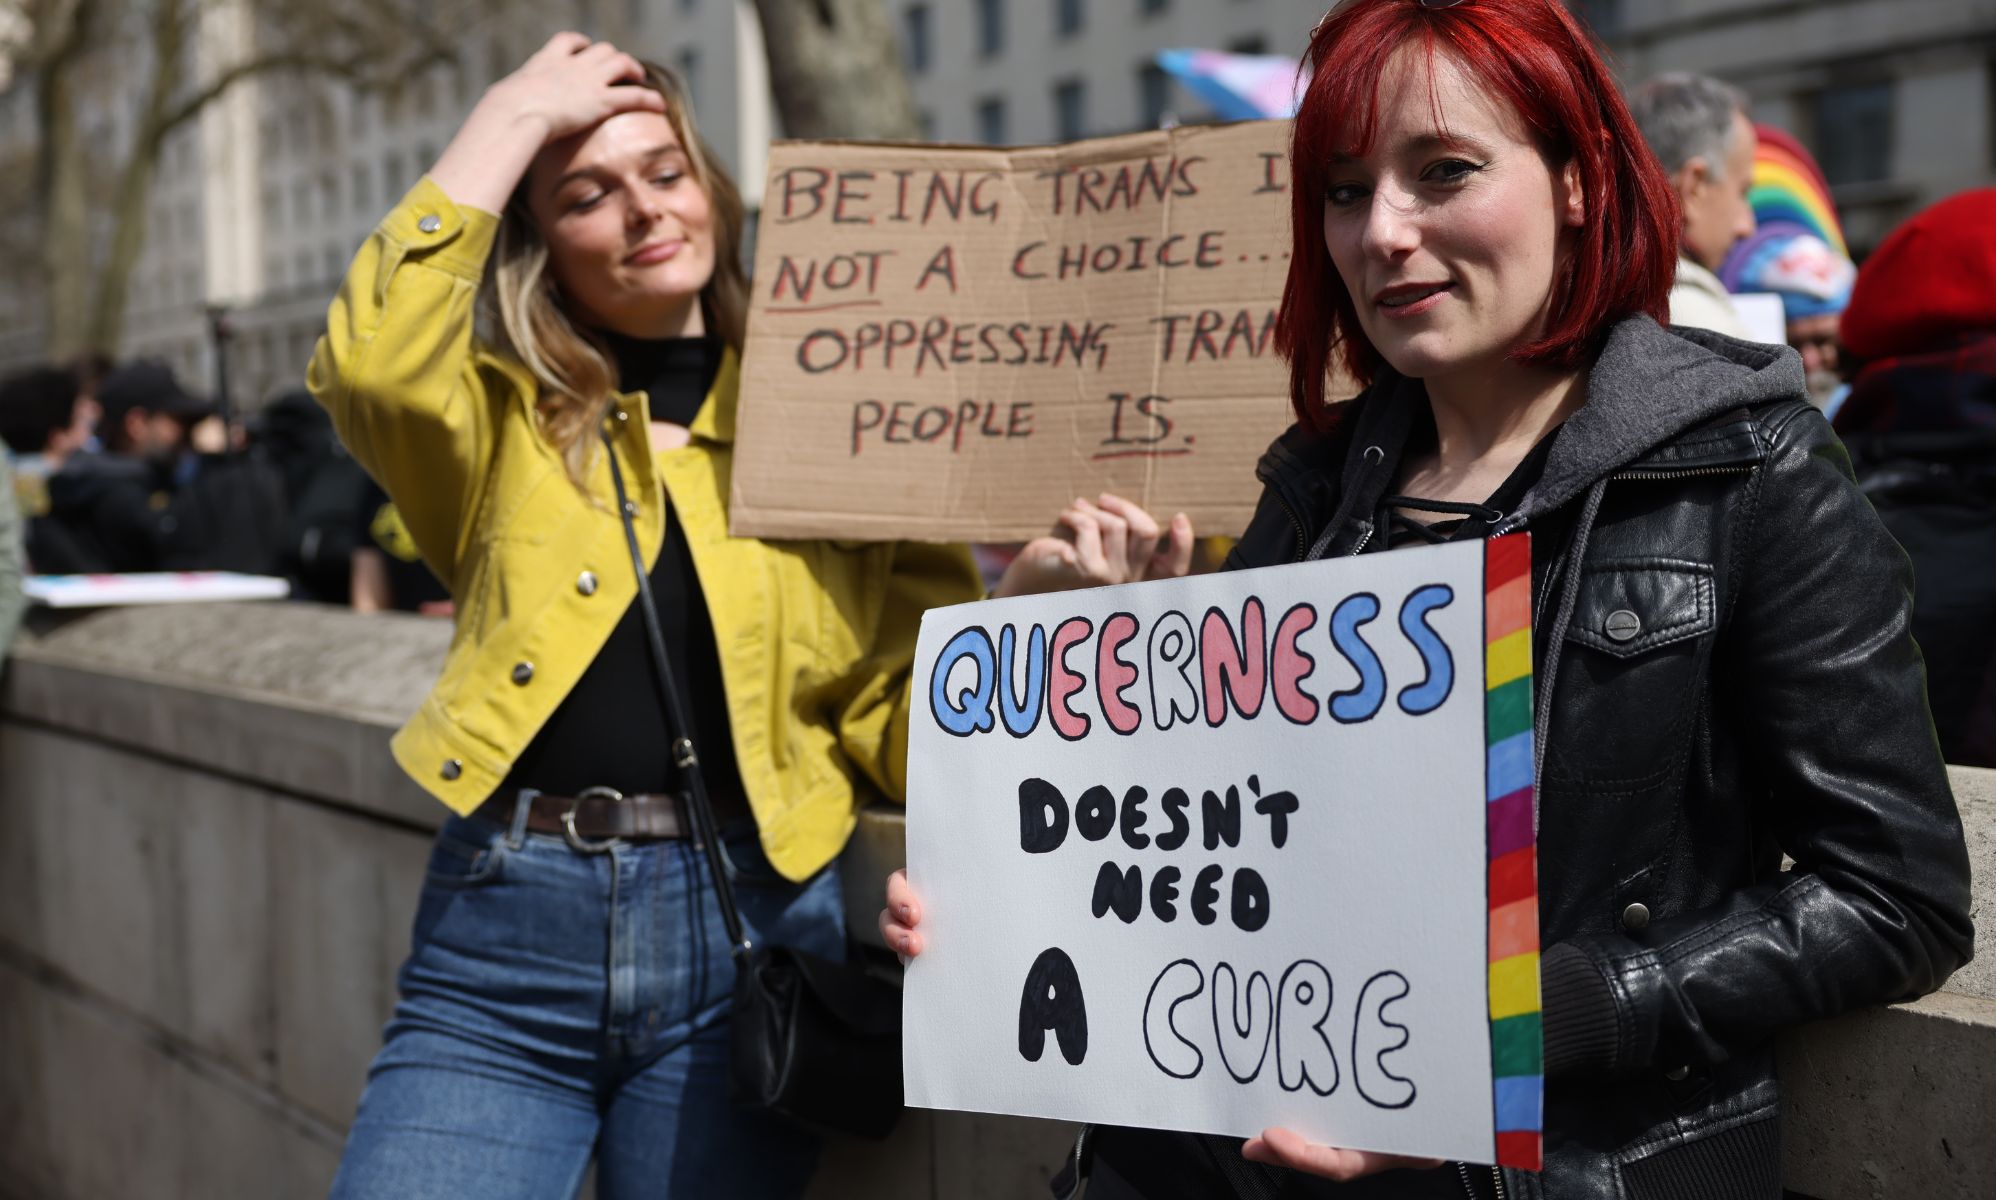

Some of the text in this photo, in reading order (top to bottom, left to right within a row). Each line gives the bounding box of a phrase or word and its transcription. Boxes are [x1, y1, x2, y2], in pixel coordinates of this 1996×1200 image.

[772, 152, 1288, 226] BEING TRANS I
[771, 230, 1291, 303] NOT A CHOICE...
[797, 316, 1117, 375] OPPRESSING
[850, 392, 1196, 456] PEOPLE IS.
[929, 583, 1455, 741] QUEERNESS
[1018, 774, 1300, 854] DOESN'T
[1091, 860, 1271, 932] NEED
[1018, 946, 1417, 1109] A CURE
